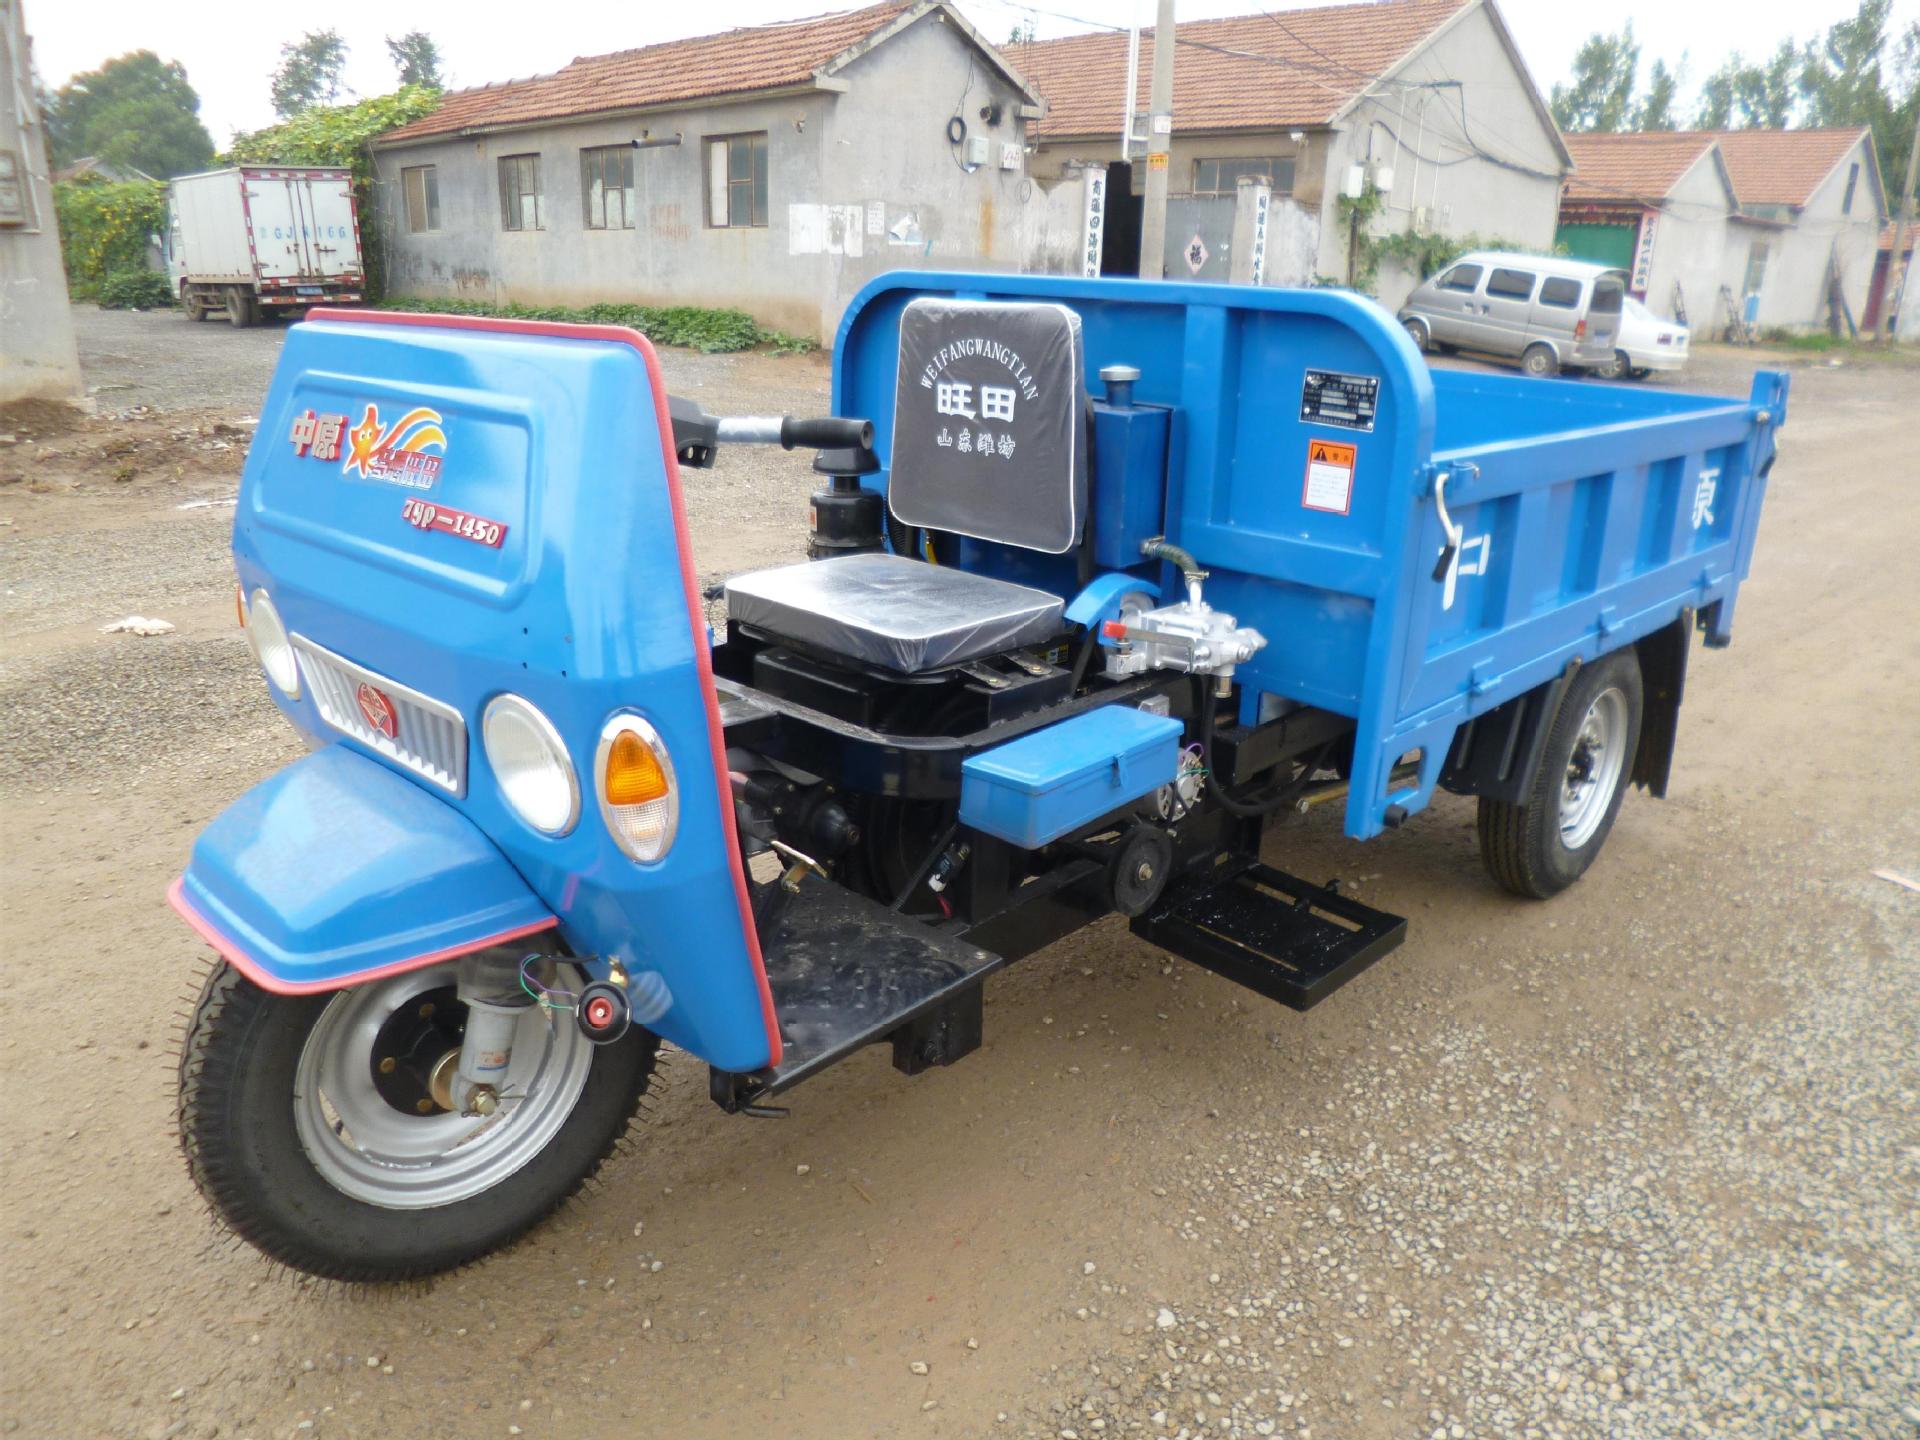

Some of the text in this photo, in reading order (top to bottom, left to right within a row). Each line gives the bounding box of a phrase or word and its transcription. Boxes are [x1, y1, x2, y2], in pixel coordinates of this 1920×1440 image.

[920, 339, 1039, 400] WEIFANGWANGTIAN
[937, 383, 1017, 423] 旺田
[289, 409, 348, 461] 中原
